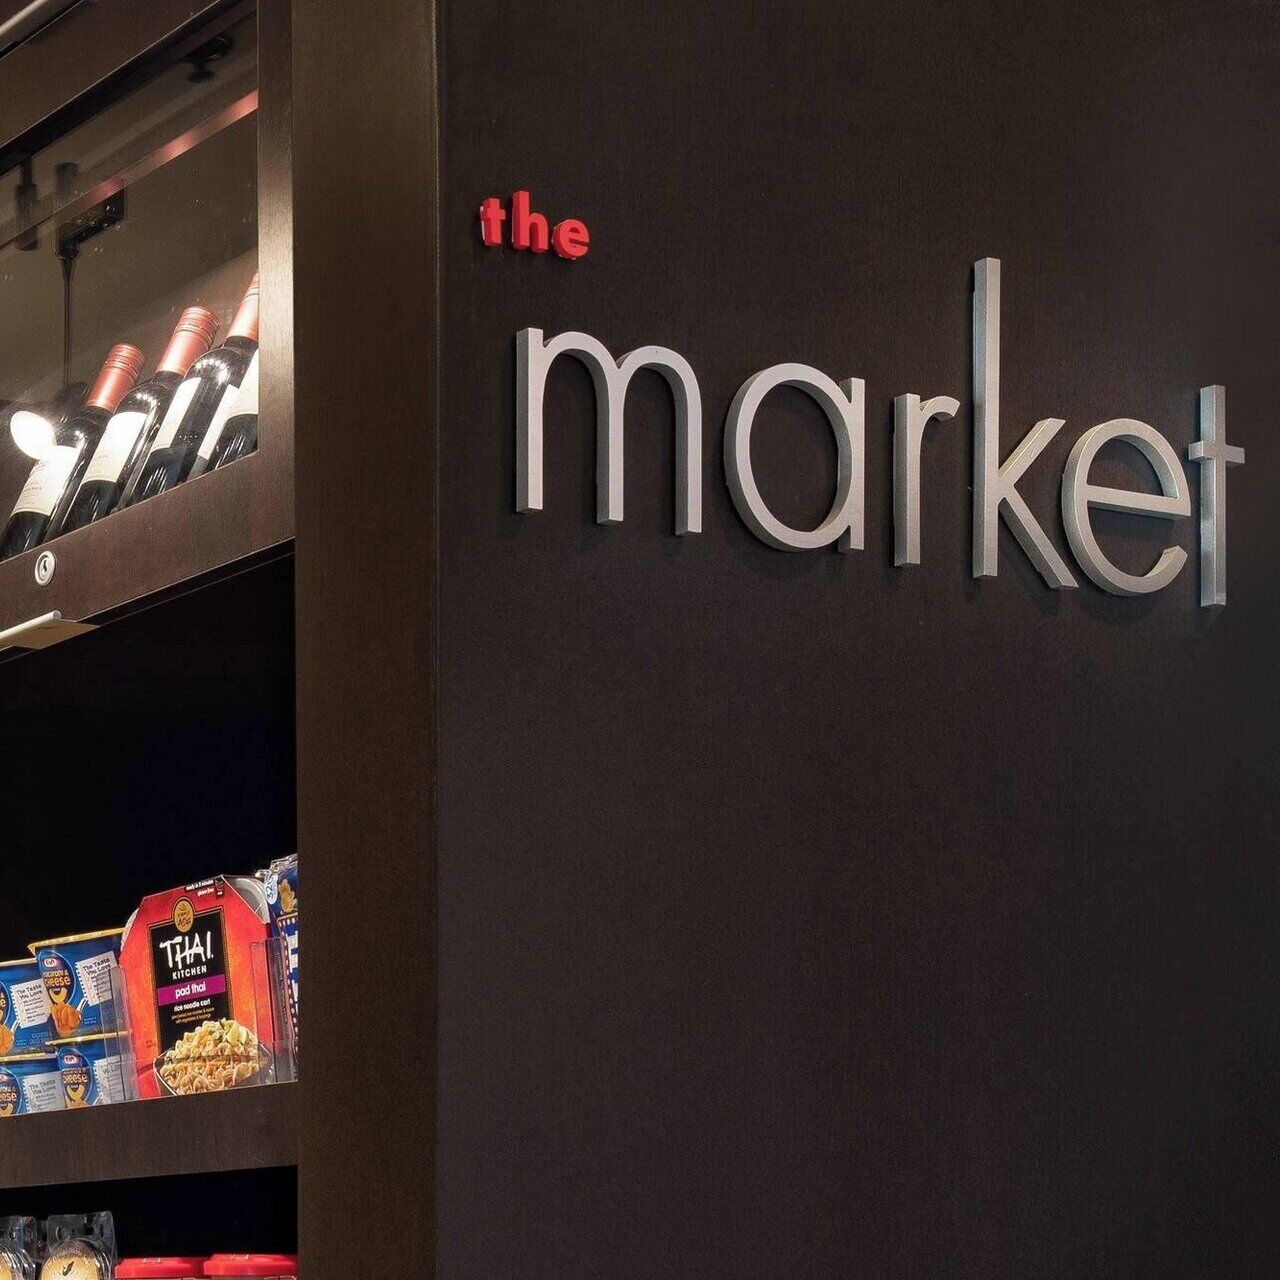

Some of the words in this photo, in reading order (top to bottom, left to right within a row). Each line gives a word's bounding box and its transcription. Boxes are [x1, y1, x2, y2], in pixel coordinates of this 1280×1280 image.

[480, 190, 590, 260] the
[515, 257, 1245, 606] market
[159, 931, 213, 970] THAI
[82, 963, 94, 972] The
[94, 958, 110, 968] Taste
[97, 964, 112, 974] Love
[172, 965, 207, 980] KITCHEN
[27, 984, 42, 993] Taste
[30, 990, 43, 998] Love
[175, 986, 190, 999] pad
[191, 981, 206, 993] thai
[184, 1001, 200, 1010] noodle
